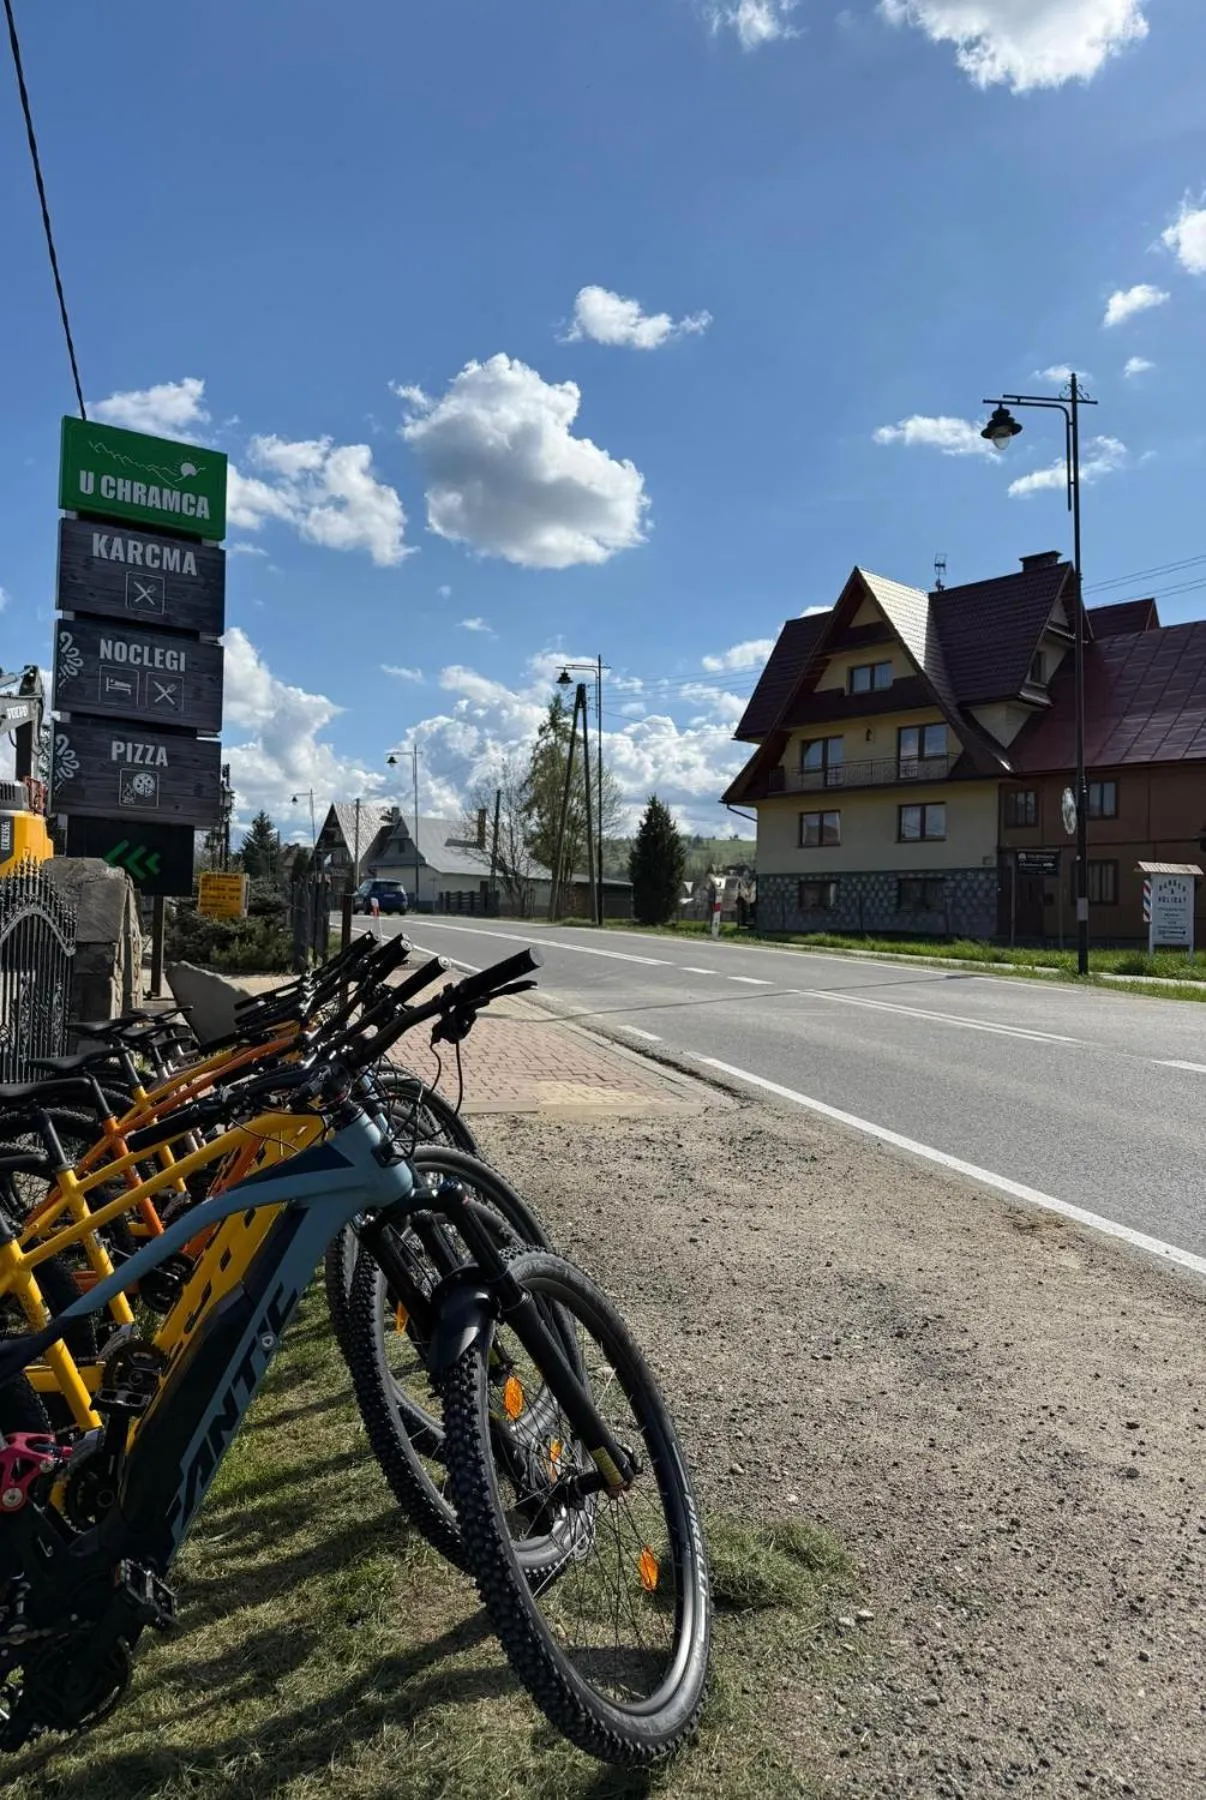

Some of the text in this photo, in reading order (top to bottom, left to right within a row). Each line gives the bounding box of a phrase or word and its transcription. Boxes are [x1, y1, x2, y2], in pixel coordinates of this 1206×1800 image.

[79, 470, 211, 520] U CHRAMCA
[92, 532, 198, 577] KARCMA
[100, 638, 186, 673] NOCLEGI
[111, 740, 169, 768] PIZZA
[684, 1493, 707, 1597] PIRELLI
